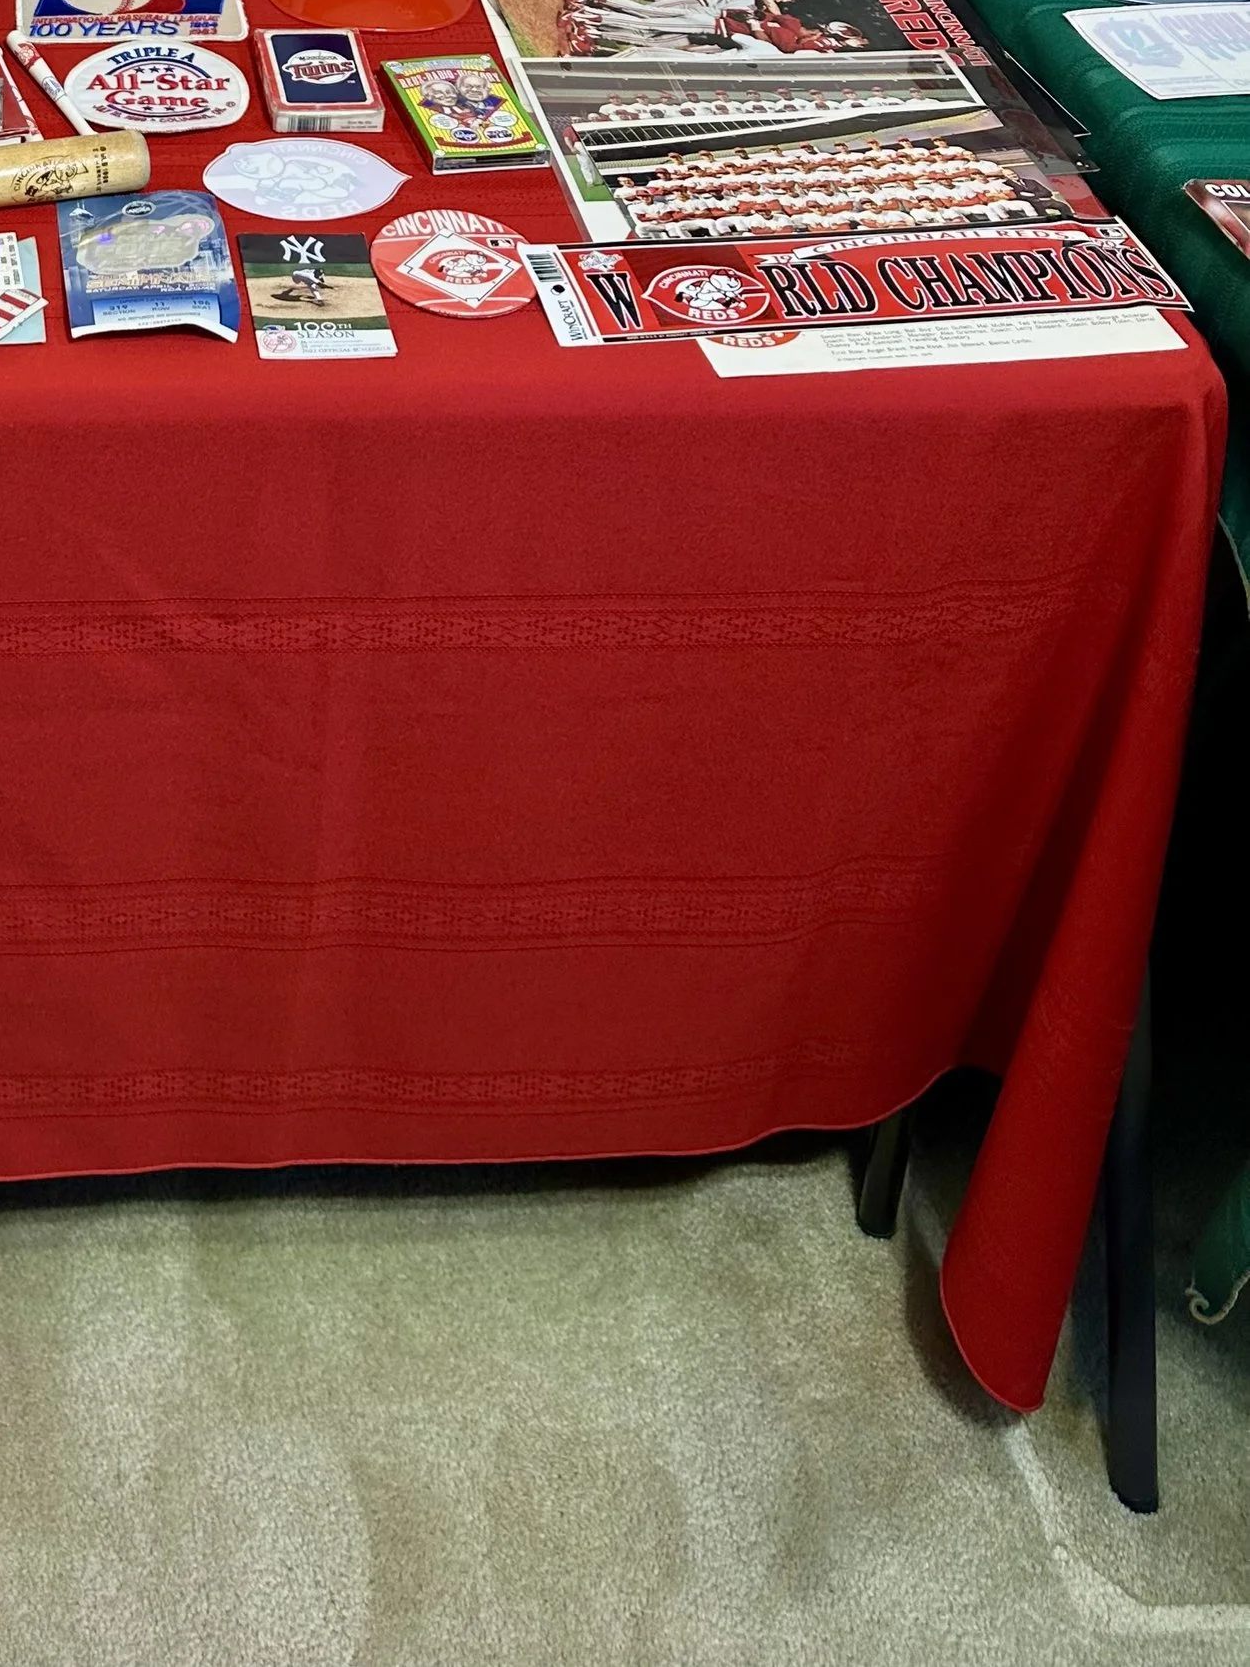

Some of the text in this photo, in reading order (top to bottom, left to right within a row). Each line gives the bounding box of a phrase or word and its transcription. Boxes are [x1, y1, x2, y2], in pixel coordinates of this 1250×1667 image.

[29, 20, 179, 37] 100 YEARS
[107, 47, 195, 65] TRIPLE A
[283, 61, 355, 80] Twins
[86, 73, 230, 91] All-Star
[105, 91, 209, 108] Game
[381, 209, 505, 237] CINCINNATI
[279, 235, 327, 264] NY
[812, 230, 982, 253] CINCINNATI
[999, 229, 1072, 239] REDS
[445, 276, 481, 285] REDS
[659, 269, 708, 289] CINCINNATI
[876, 243, 1176, 313] CHAMPIONS
[688, 308, 740, 321] REDS
[293, 321, 352, 333] 100TH
[297, 331, 356, 339] SEASON
[723, 332, 776, 347] REDS
